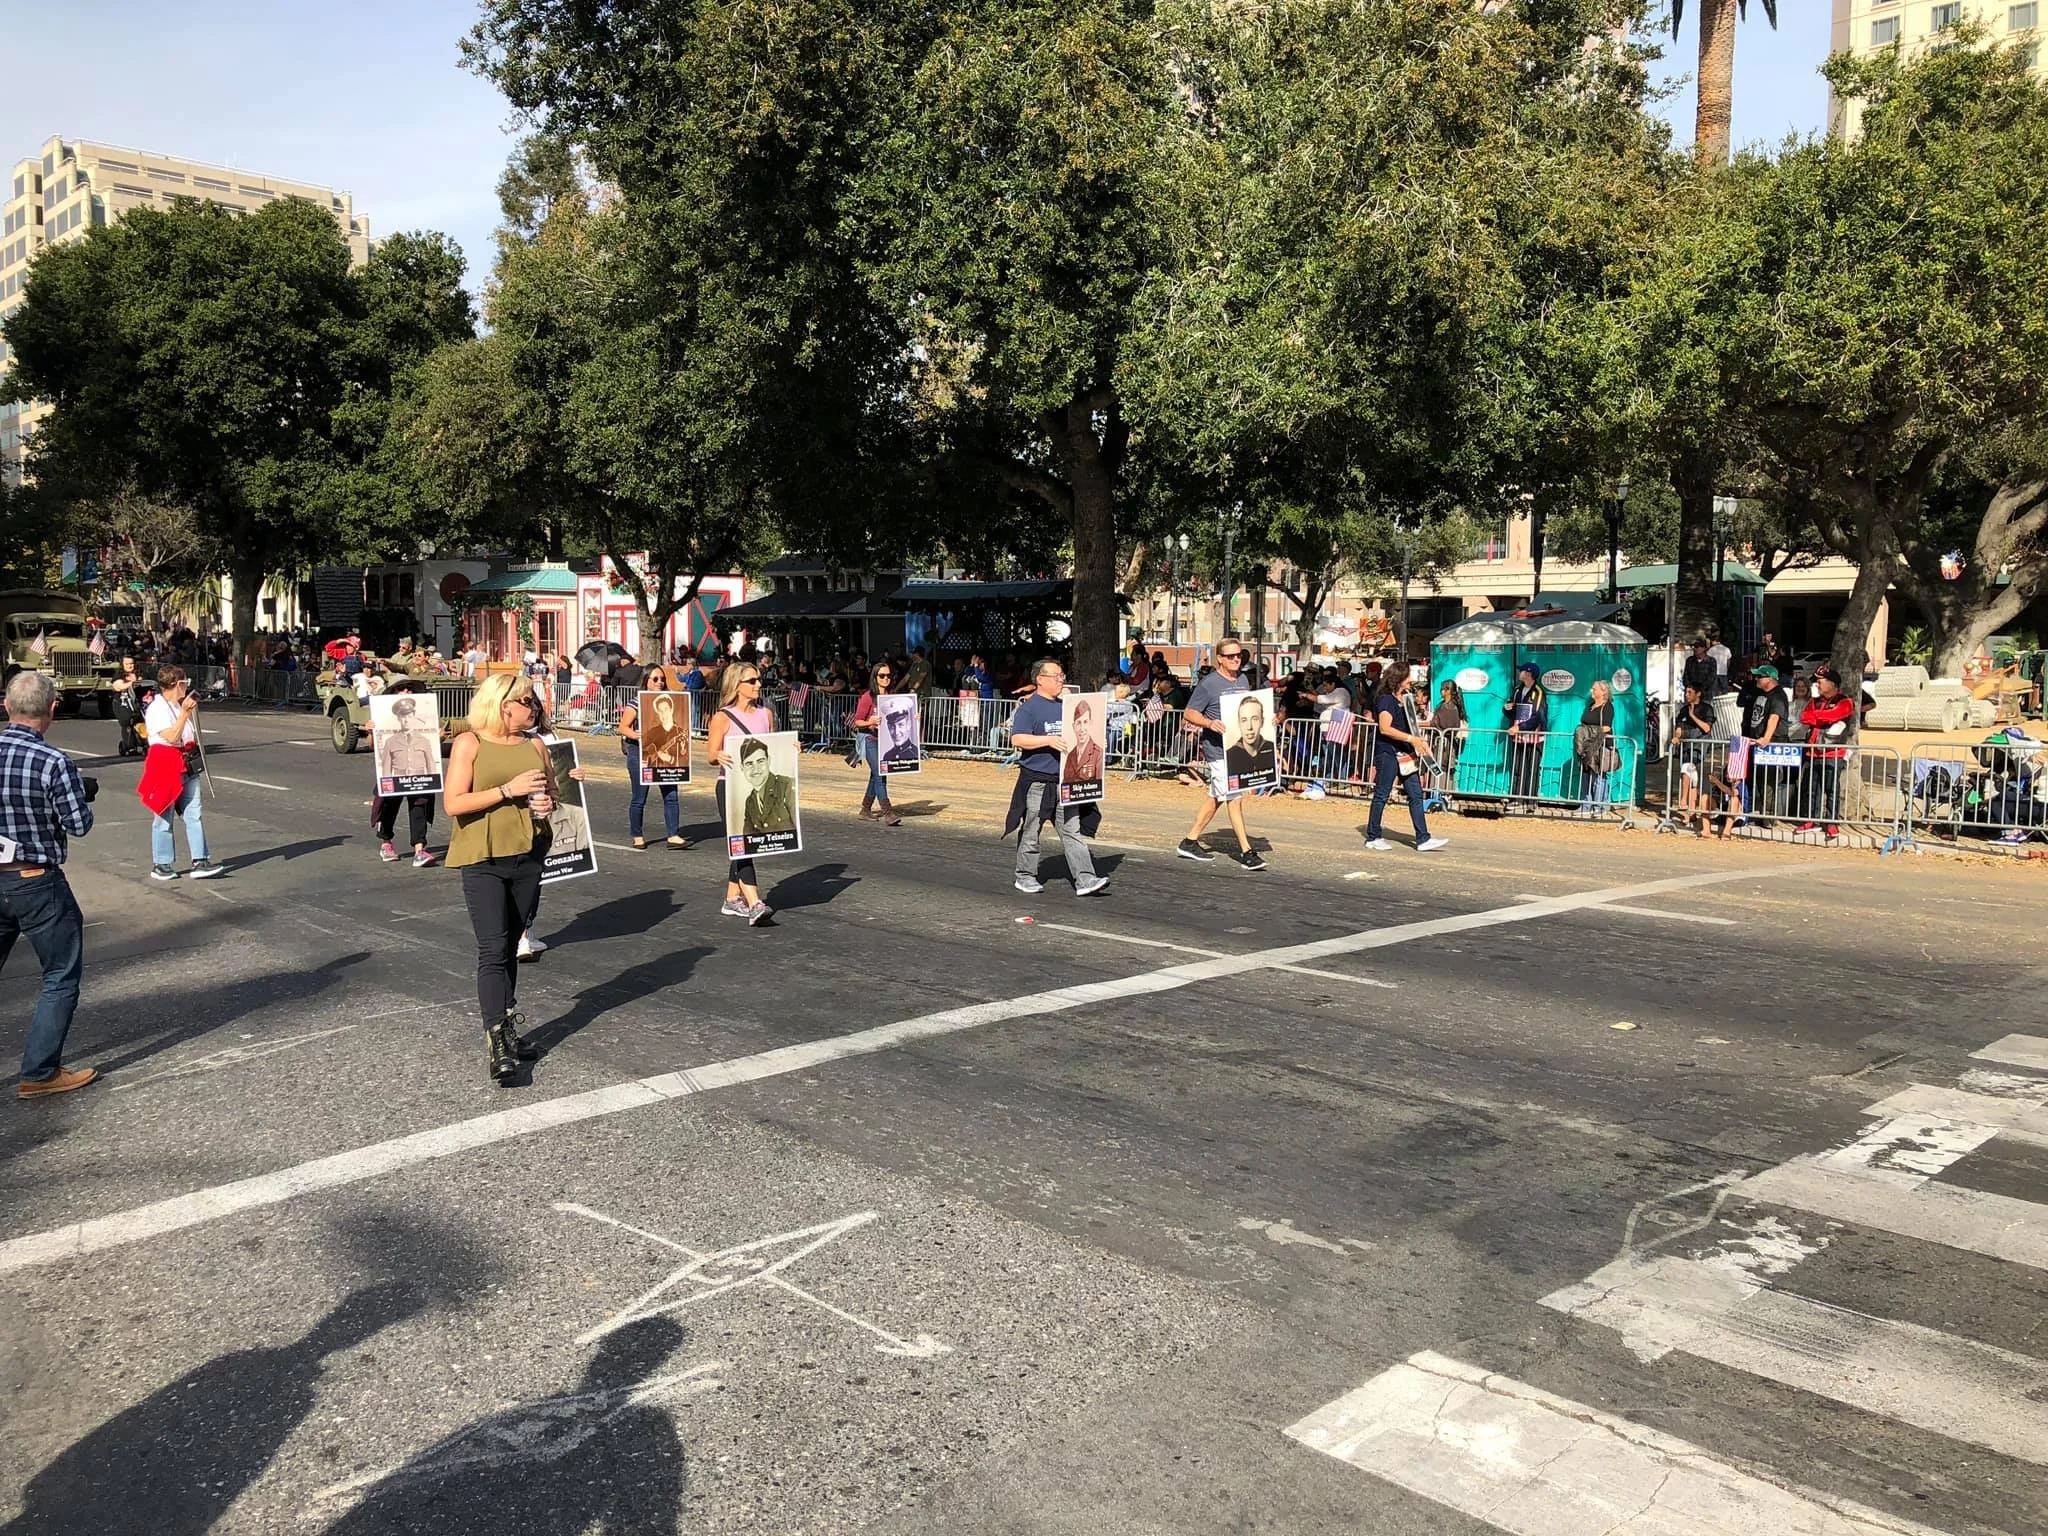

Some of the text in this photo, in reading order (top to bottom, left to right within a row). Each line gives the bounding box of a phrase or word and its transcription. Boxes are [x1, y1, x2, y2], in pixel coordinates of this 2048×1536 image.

[747, 832, 794, 844] Tony Teixeira
[544, 852, 584, 867] Gonzales
